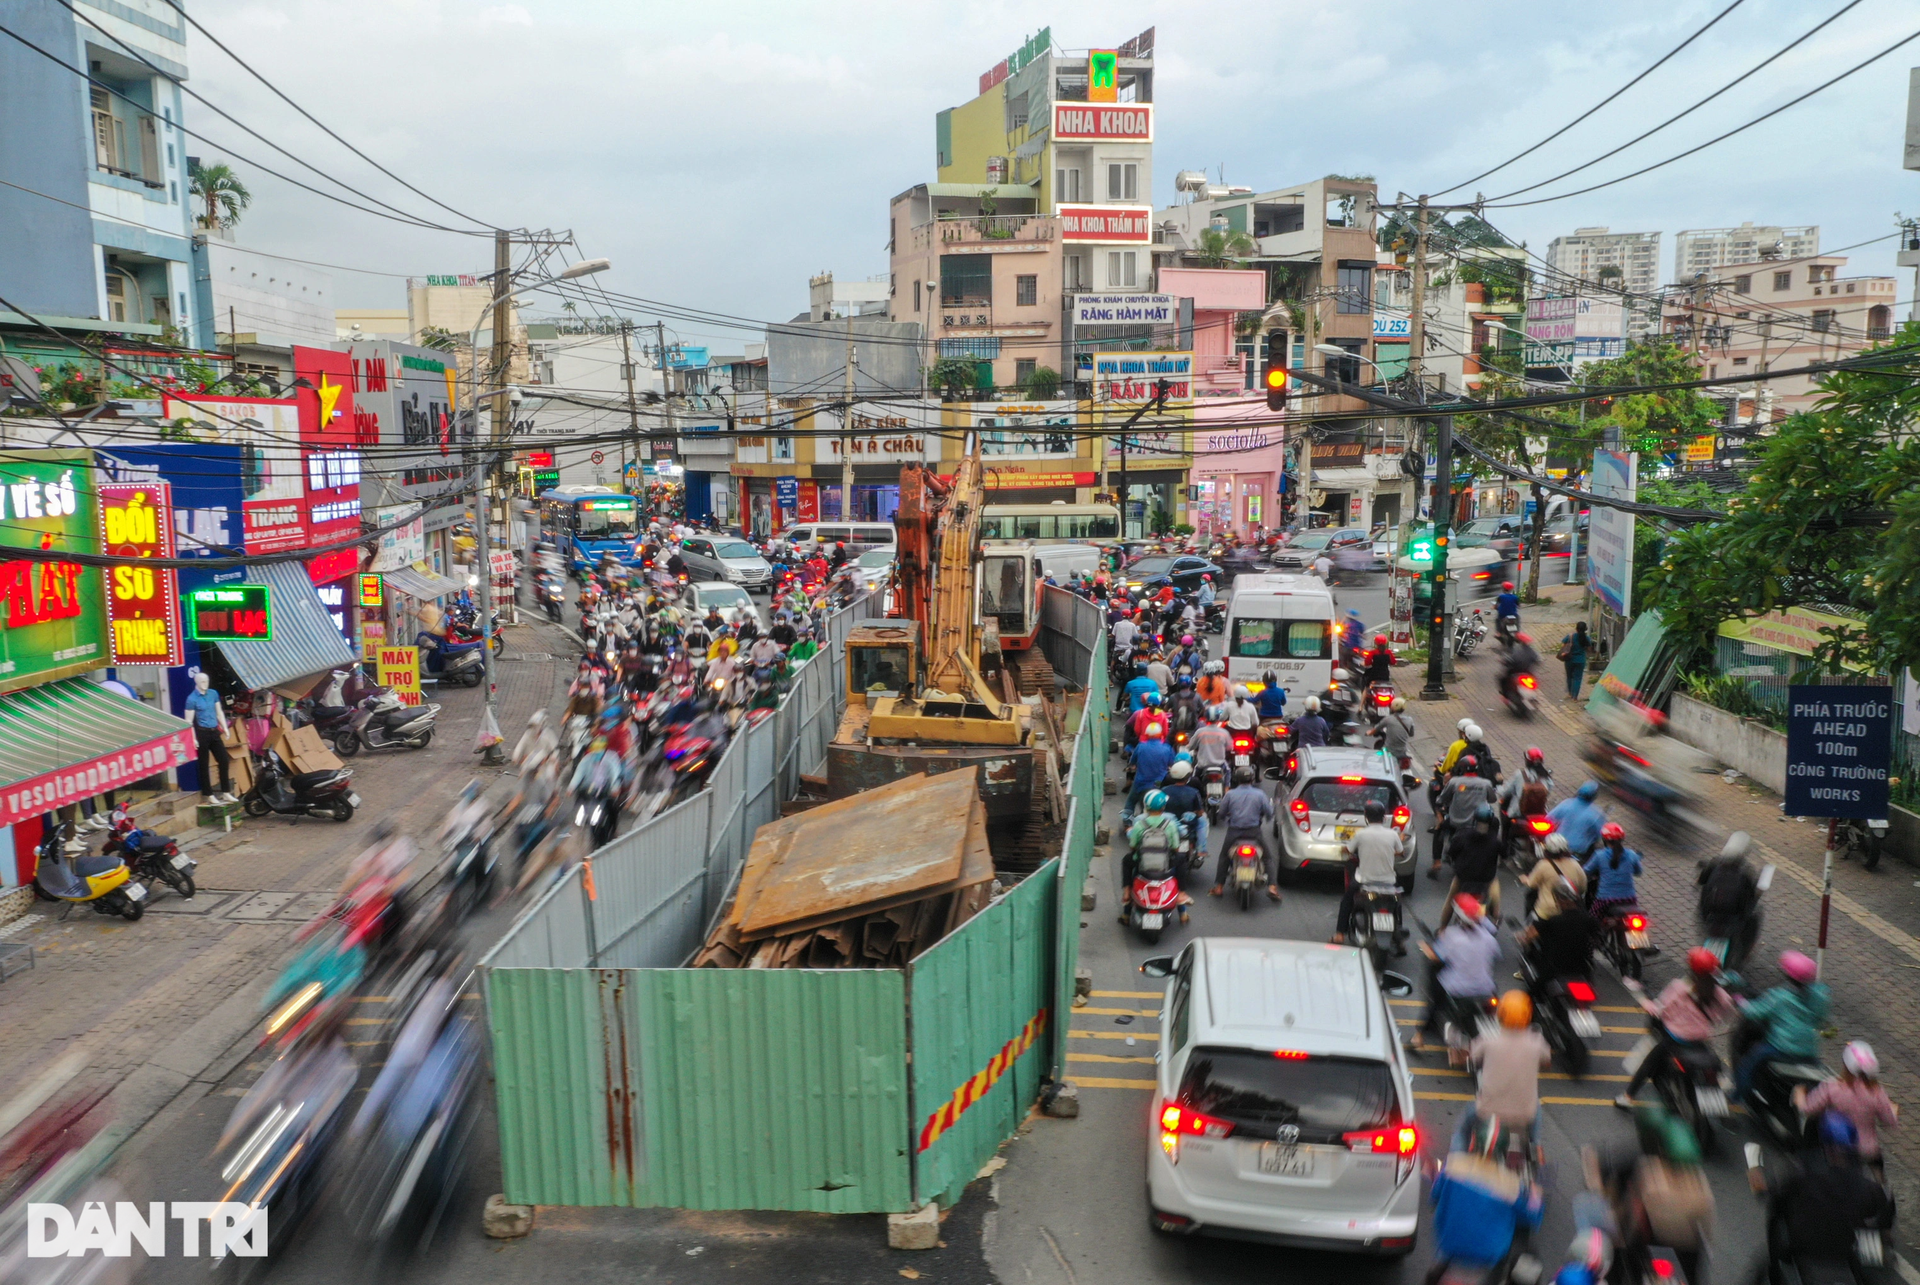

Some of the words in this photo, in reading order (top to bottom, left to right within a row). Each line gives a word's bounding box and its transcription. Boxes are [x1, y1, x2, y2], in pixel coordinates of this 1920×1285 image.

[1058, 110, 1095, 133] NHA
[1100, 111, 1147, 134] KHOA
[1062, 216, 1079, 232] NHA
[1081, 216, 1105, 233] KHOA
[1107, 211, 1132, 233] THẨM
[1134, 215, 1148, 233] MỸ
[426, 274, 440, 286] NHA
[441, 274, 458, 286] KHOA
[458, 274, 476, 286] TITAN
[1103, 295, 1123, 303] KHÁM
[1125, 295, 1149, 303] CHUYÊN
[1578, 300, 1590, 314] IN
[1081, 307, 1113, 320] RĂNG
[1116, 306, 1141, 320] HÀM
[1144, 306, 1168, 322] MẶT
[1528, 301, 1540, 319] IN
[1543, 299, 1574, 317] DECAL
[1389, 320, 1407, 332] 252
[1554, 320, 1574, 338] RÔN
[366, 349, 388, 393] DÁN
[1120, 361, 1146, 374] KHOA
[1147, 355, 1174, 373] THẨM
[1175, 357, 1190, 373] MỸ
[220, 405, 256, 418] SAKOS
[996, 405, 1046, 416] OPTIC
[876, 415, 908, 428] KÍNH
[831, 440, 863, 454] TN
[867, 435, 878, 453] Á
[883, 434, 924, 453] CHÂU
[1207, 427, 1267, 450] sociolla
[1004, 464, 1025, 474] Ngân
[45, 469, 76, 517] SỐ
[105, 492, 156, 544] ĐỔI
[248, 505, 298, 529] TRANG
[491, 554, 503, 564] SỬA
[504, 553, 513, 561] XE
[504, 563, 513, 571] XE
[114, 551, 154, 600] SỐ
[112, 611, 168, 655] TRÚNG
[233, 610, 267, 637] LẠC
[381, 649, 414, 665] MÁY
[384, 669, 414, 689] TRỢ
[1794, 700, 1831, 718] PHÍA
[1833, 699, 1888, 718] TRƯỚC
[1812, 721, 1867, 737] AHEAD
[1815, 741, 1857, 757] 100m
[8, 745, 168, 814] vesotanphat.com
[1788, 761, 1825, 777] CÔNG
[1831, 764, 1886, 780] TRƯỜNG
[1810, 787, 1861, 802] WORKS
